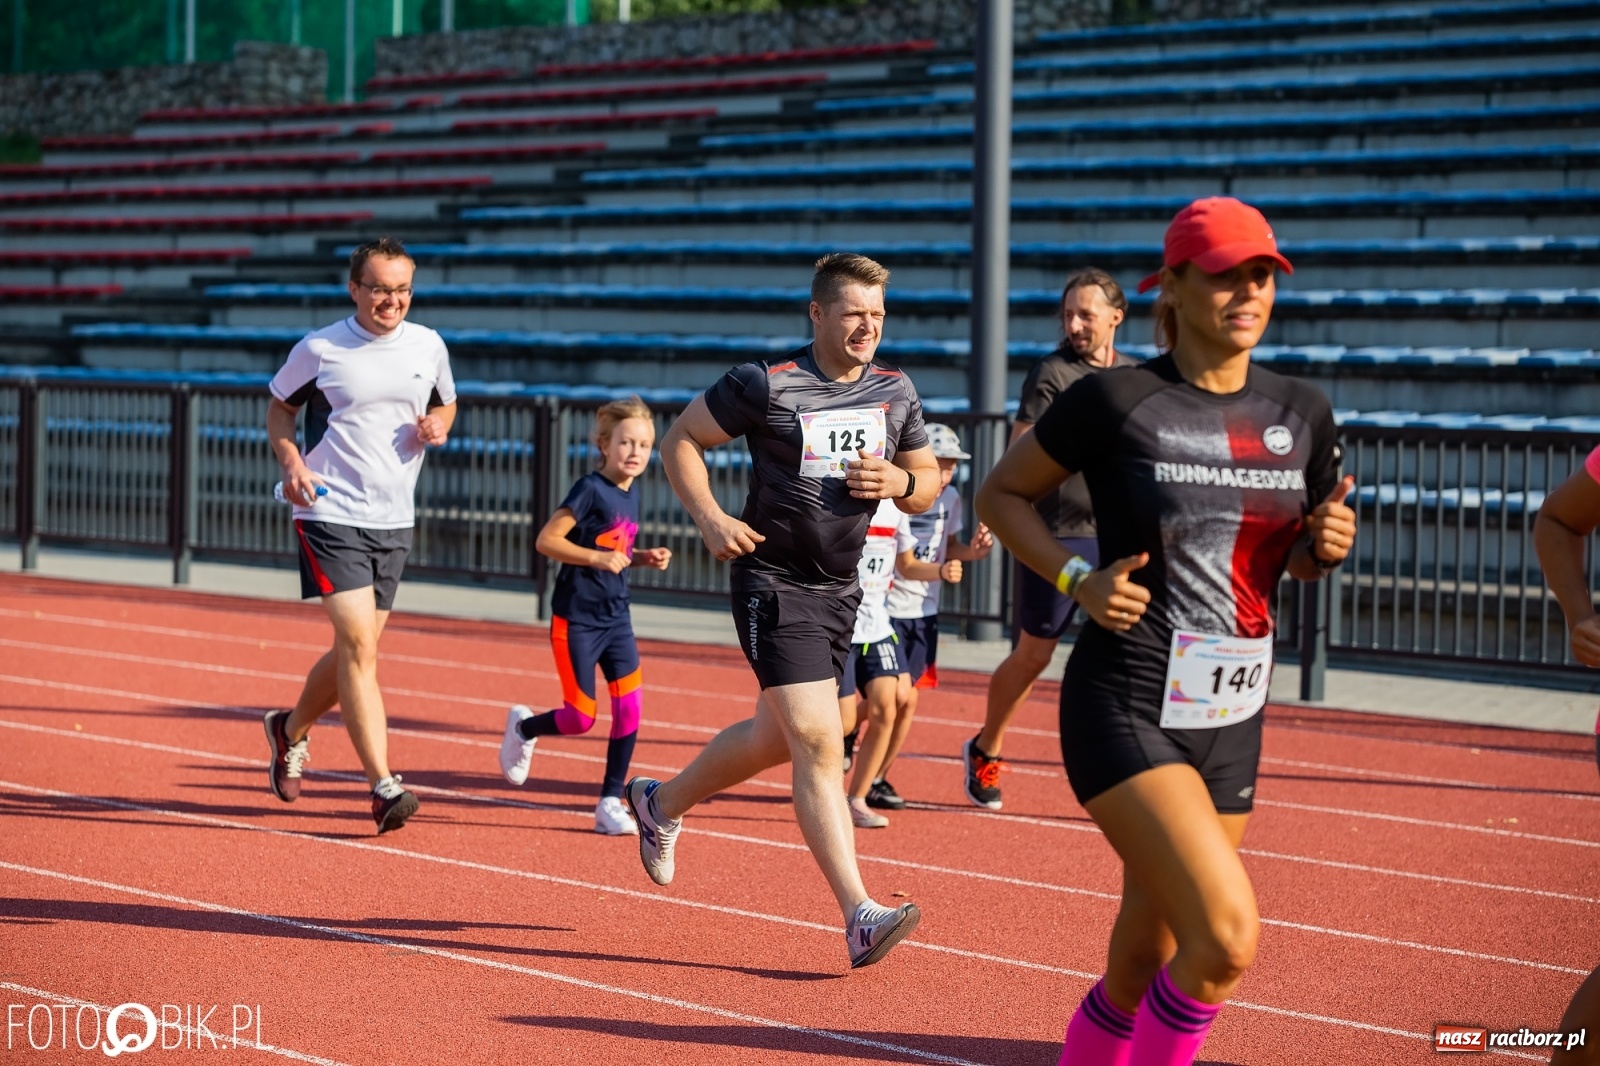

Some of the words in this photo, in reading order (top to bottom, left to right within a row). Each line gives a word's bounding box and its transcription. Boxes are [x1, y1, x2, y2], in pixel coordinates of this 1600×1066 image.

[828, 428, 866, 452] 125
[867, 558, 884, 574] 47
[1212, 663, 1263, 694] 140
